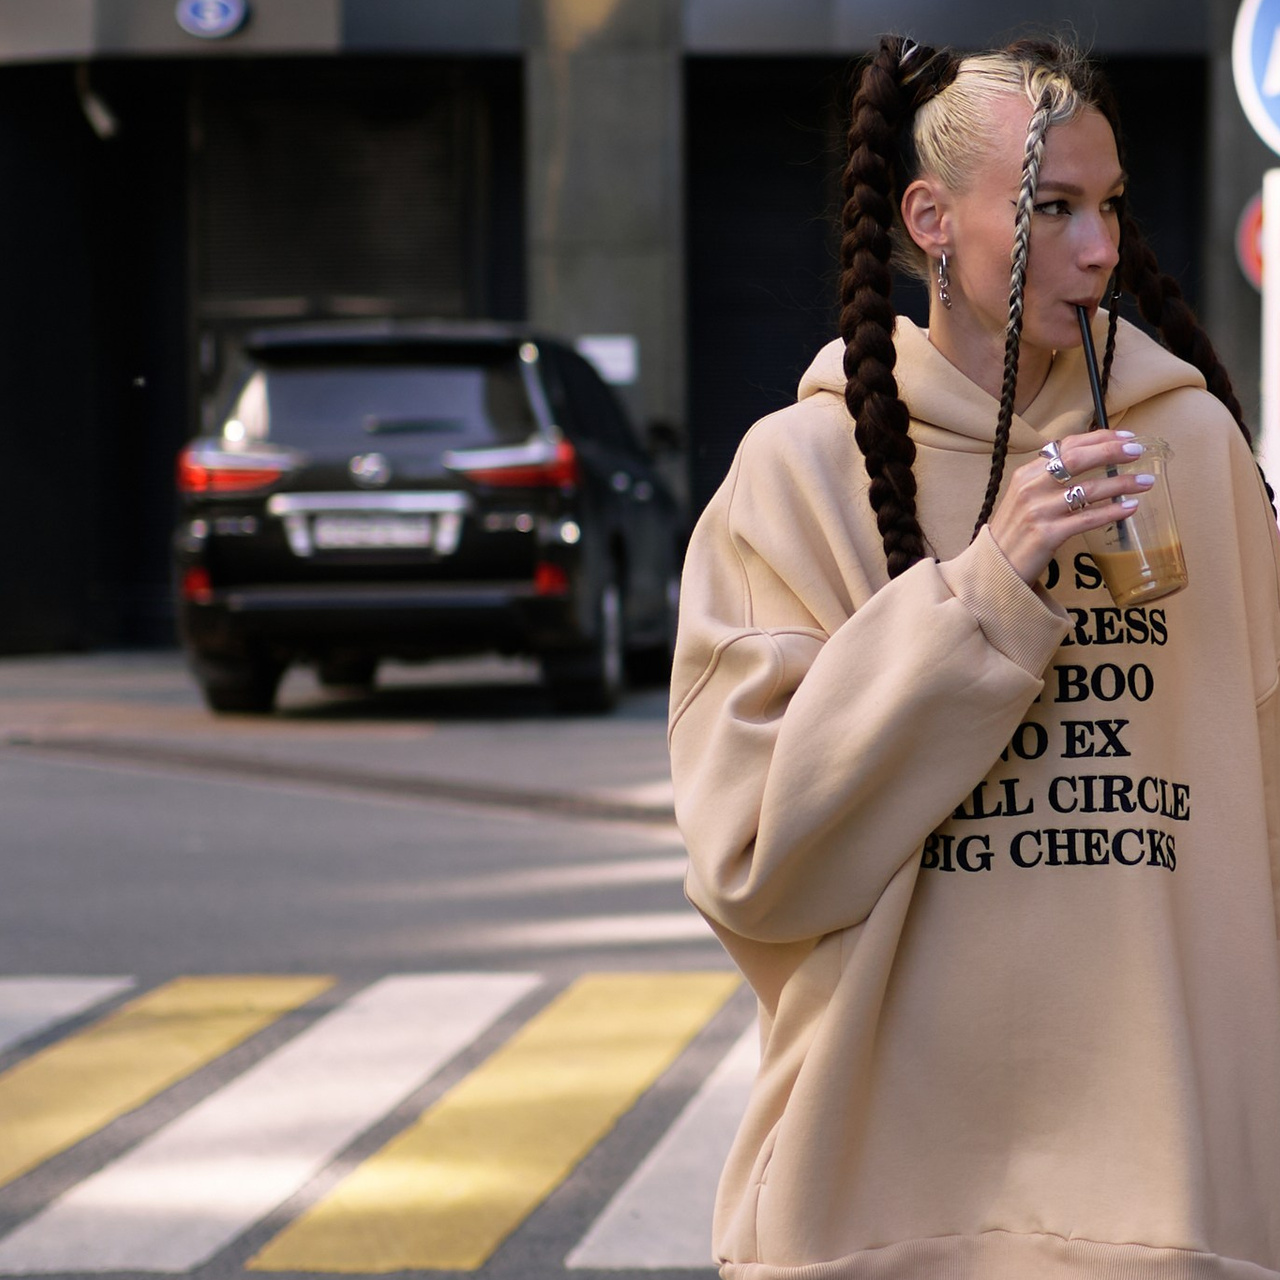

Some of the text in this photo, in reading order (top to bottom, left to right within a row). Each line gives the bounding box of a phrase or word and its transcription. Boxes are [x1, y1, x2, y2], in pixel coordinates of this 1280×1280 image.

[1060, 607, 1168, 646] RESS
[1053, 663, 1154, 703] BOO
[1000, 719, 1132, 762] O EX
[1048, 775, 1190, 821] CIRCLE
[920, 828, 1177, 872] BIG CHECKS
